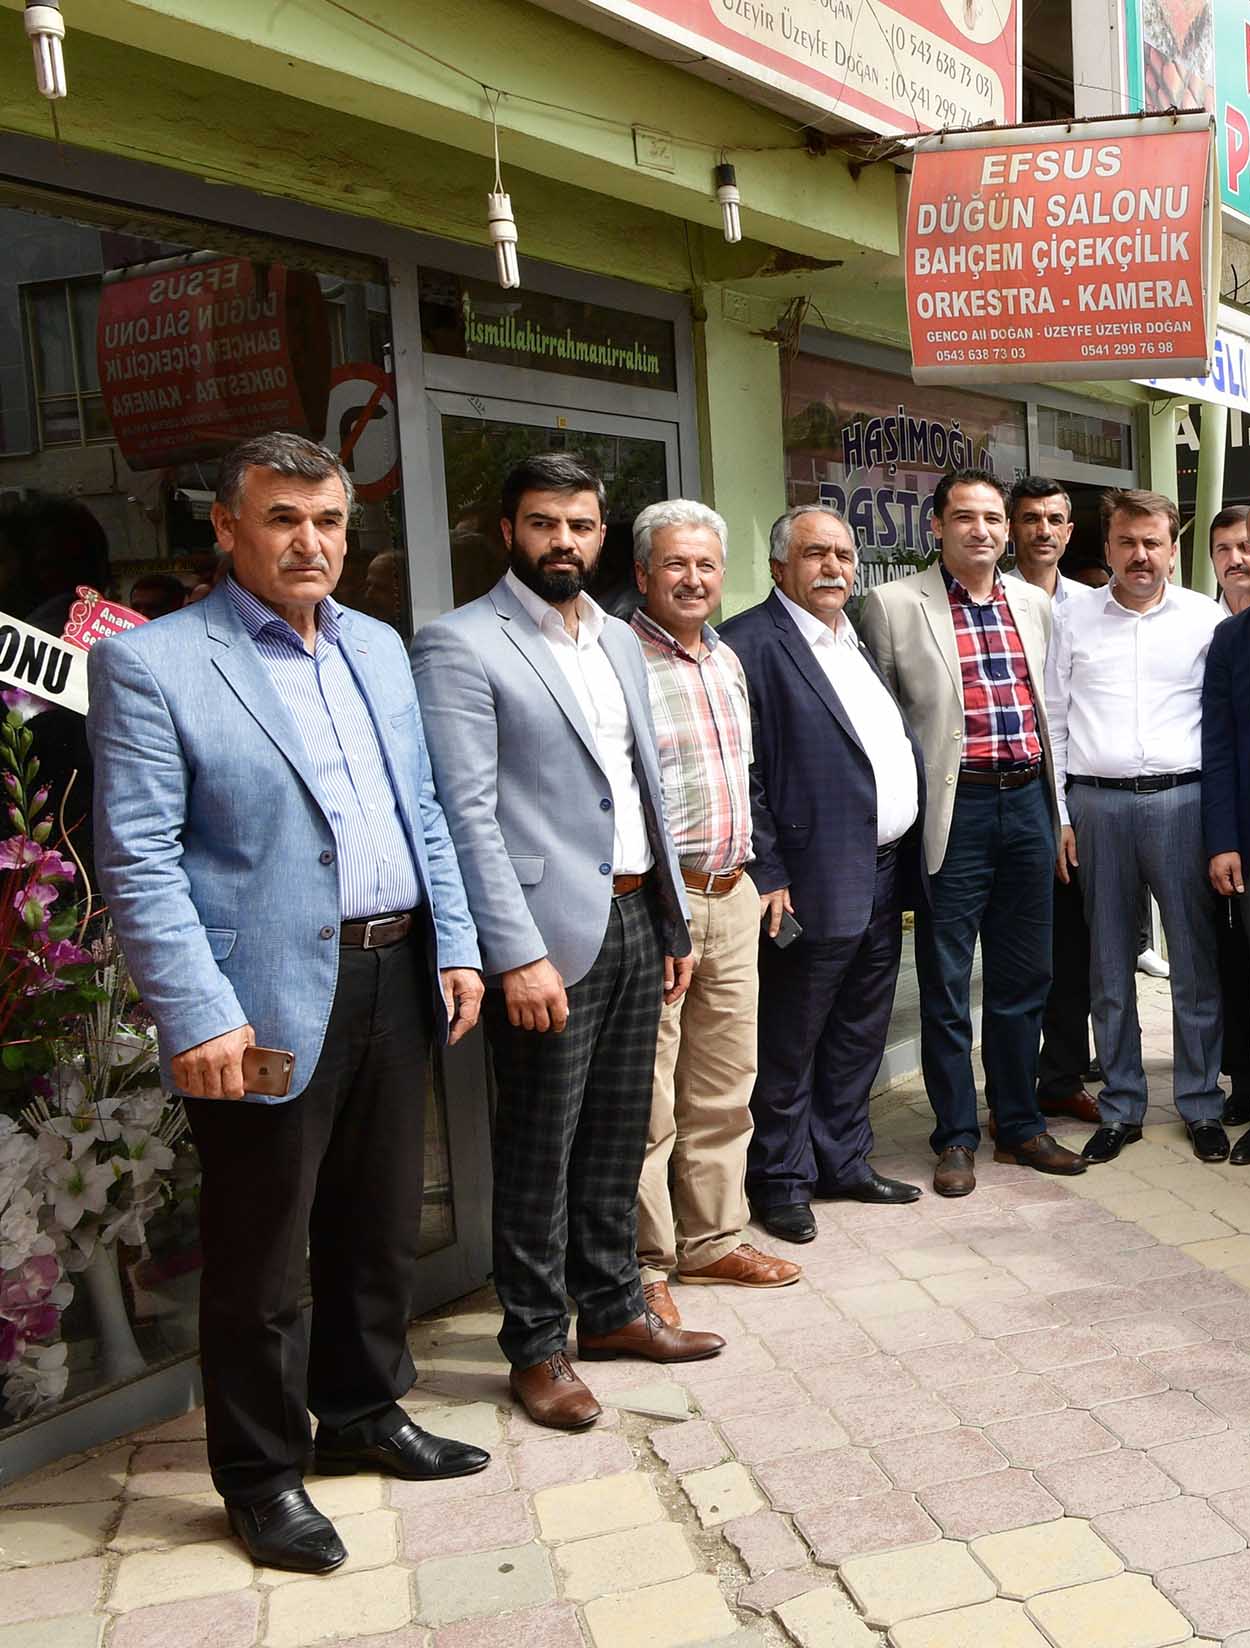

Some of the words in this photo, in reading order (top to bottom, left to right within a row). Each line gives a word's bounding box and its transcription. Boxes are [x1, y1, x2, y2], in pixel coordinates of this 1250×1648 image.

[835, 40, 879, 85] DOĞAN
[911, 81, 930, 111] 541
[935, 94, 957, 123] 299
[911, 34, 931, 64] 543
[936, 50, 956, 79] 638
[960, 62, 972, 87] 73
[976, 73, 993, 106] 03)
[981, 145, 1122, 185] EFSUS
[917, 192, 1034, 235] DÜĞÜN
[1046, 185, 1189, 227] SALONU
[914, 241, 1024, 279] BAHÇEM
[1031, 226, 1190, 276] ÇİÇEKÇİLİK
[916, 286, 1055, 319] ORKESTRA
[1078, 279, 1193, 312] KAMERA
[927, 330, 968, 342] GENCO
[990, 325, 1033, 339] DOĞAN
[1044, 324, 1093, 338] ÜZEYFE
[1096, 320, 1143, 336] ÜZEYİR
[1146, 319, 1192, 333] DOĞAN
[1081, 344, 1109, 356] 0541
[1114, 342, 1136, 354] 299
[1140, 341, 1155, 353] 76
[1158, 340, 1173, 352] 98
[936, 348, 965, 361] 0543
[968, 347, 990, 360] 638
[992, 346, 1008, 359] 73
[1011, 346, 1026, 359] 03
